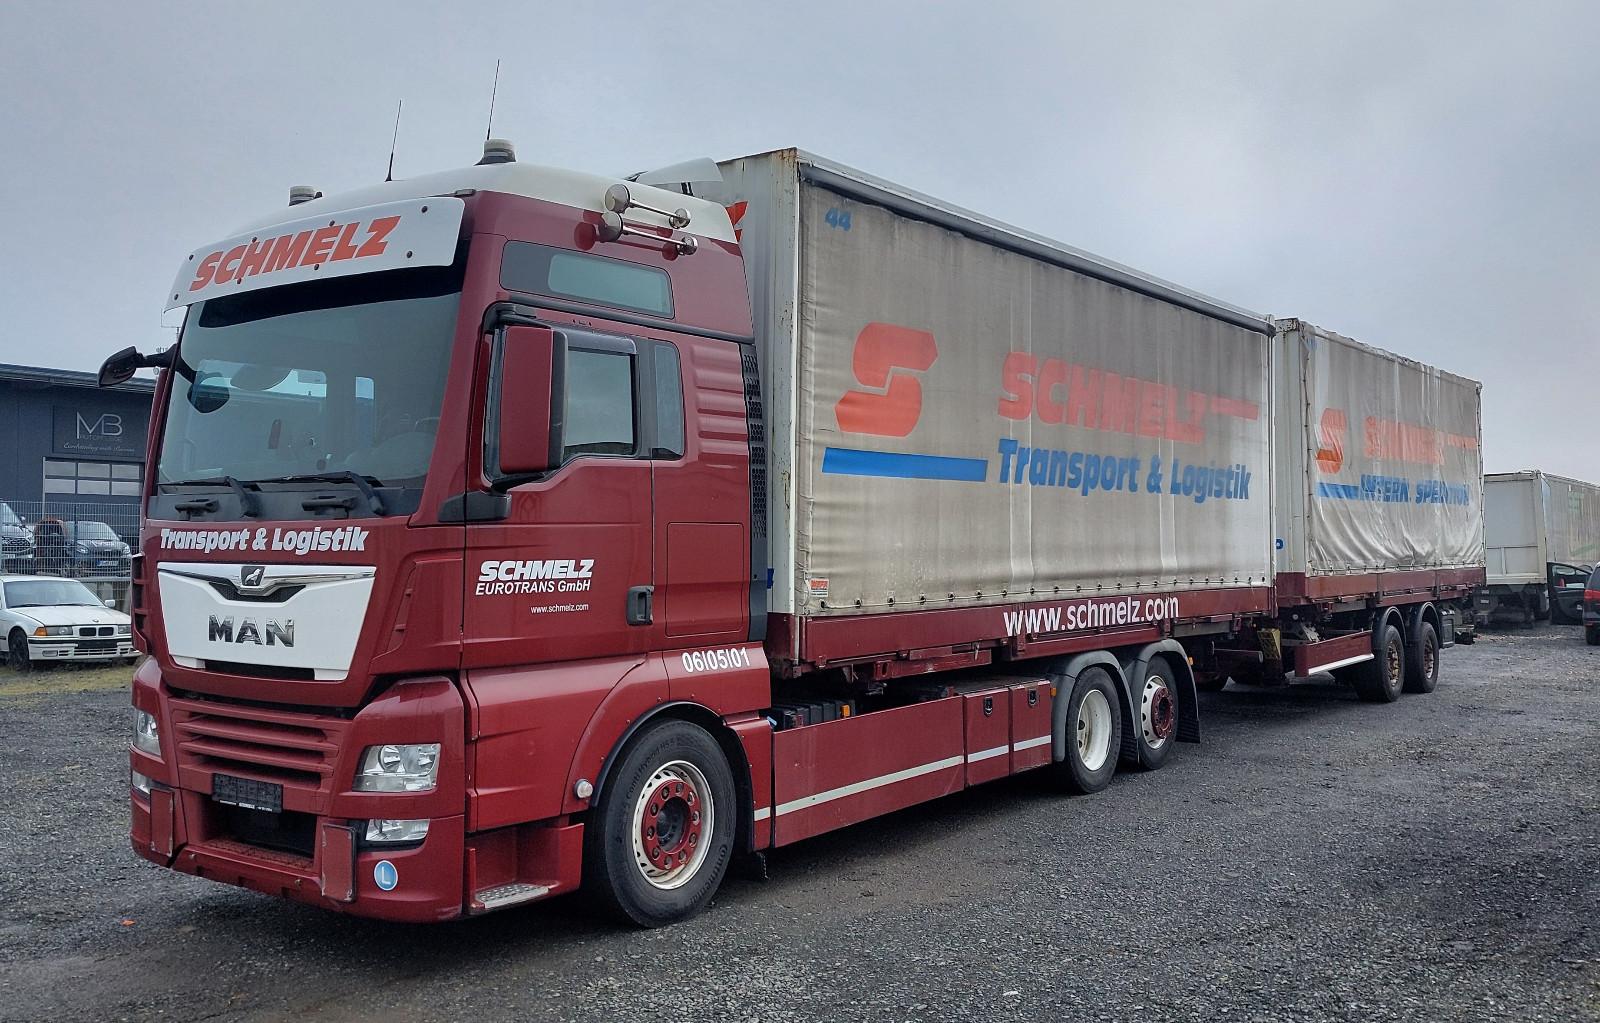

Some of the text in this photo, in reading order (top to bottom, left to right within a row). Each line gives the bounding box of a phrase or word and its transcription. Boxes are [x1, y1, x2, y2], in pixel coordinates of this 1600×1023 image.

[825, 207, 851, 231] 44
[188, 215, 401, 292] SCHMELZ
[998, 350, 1206, 444] SCHMELZ
[76, 411, 123, 439] MB
[998, 437, 1252, 504] Transport & Logistik
[160, 527, 369, 555] Transport & Logistik
[479, 559, 595, 582] SCHMELZ
[475, 579, 591, 596] EUROTRANS GmbH
[530, 602, 589, 614] www.schmelz.com
[1003, 596, 1179, 637] www.schmelz.com
[208, 614, 295, 648] MAN
[381, 866, 391, 885] L
